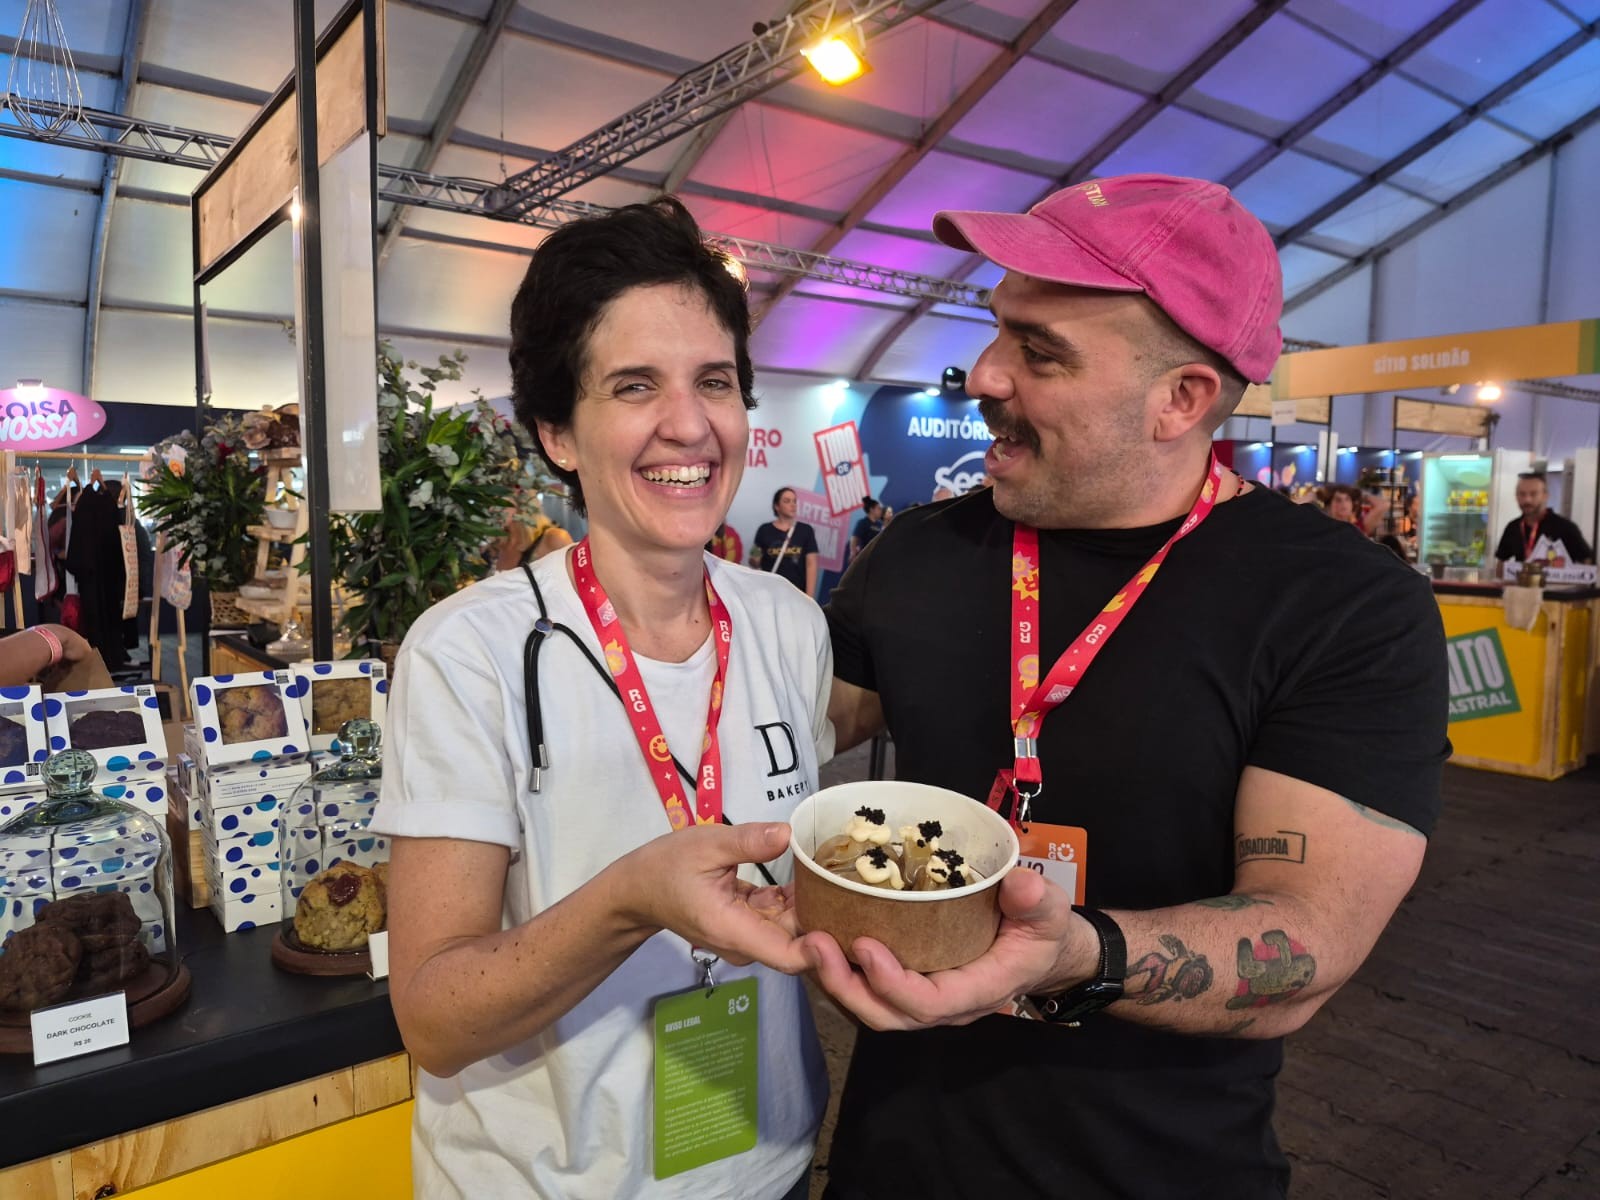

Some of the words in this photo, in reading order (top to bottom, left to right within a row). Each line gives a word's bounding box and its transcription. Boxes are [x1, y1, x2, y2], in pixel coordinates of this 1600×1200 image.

[0, 399, 75, 420] OISA
[907, 414, 996, 441] AUDITÓRI
[837, 462, 850, 475] DE
[68, 1013, 92, 1023] COOKIE
[46, 1029, 68, 1039] DARK
[69, 1018, 115, 1034] CHOCOLATE
[73, 1039, 82, 1047] R$
